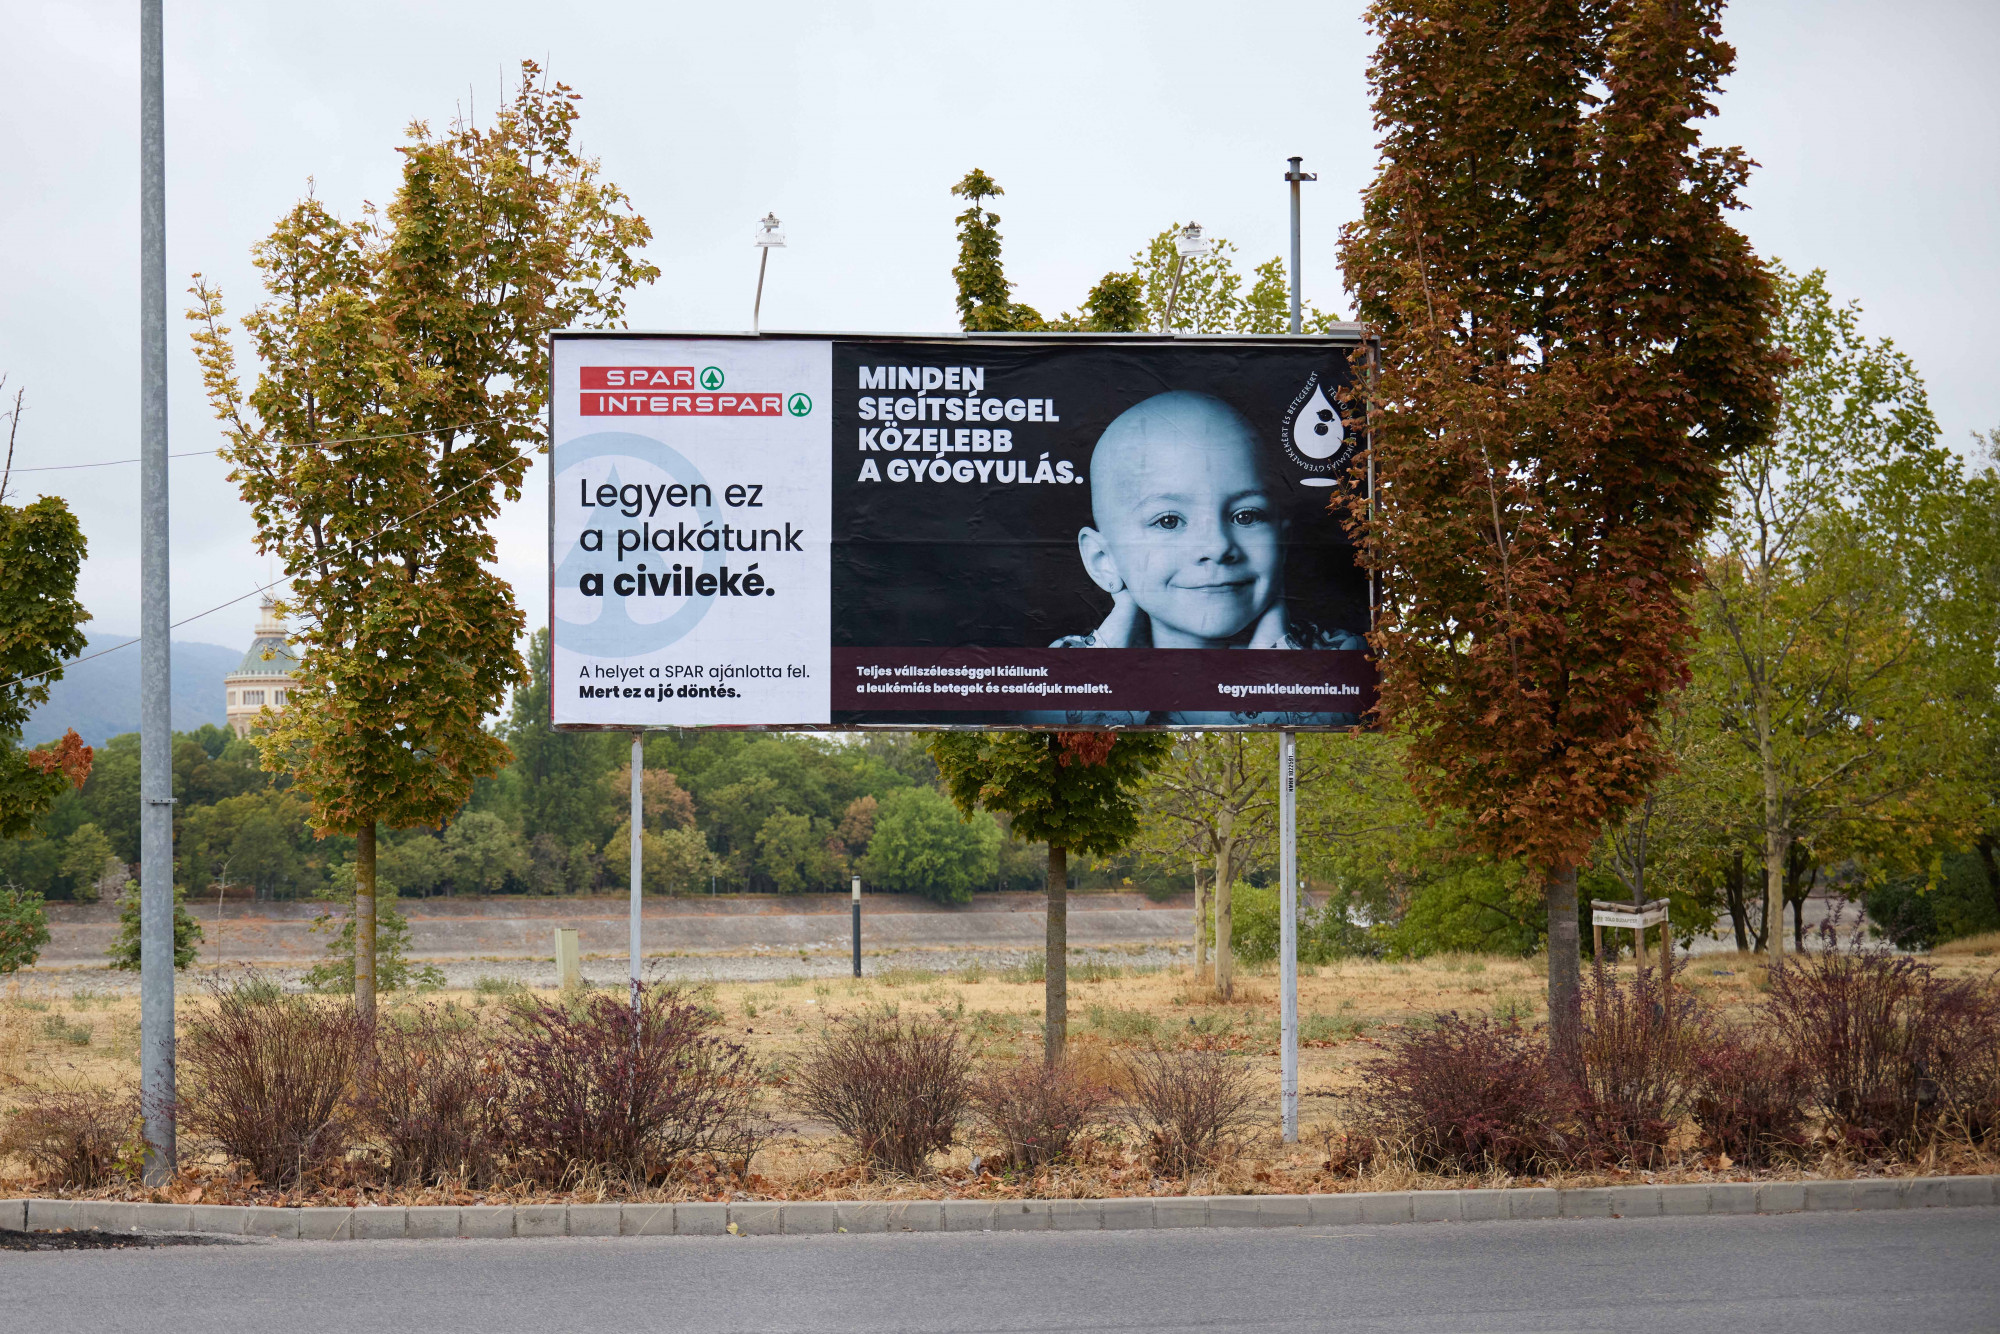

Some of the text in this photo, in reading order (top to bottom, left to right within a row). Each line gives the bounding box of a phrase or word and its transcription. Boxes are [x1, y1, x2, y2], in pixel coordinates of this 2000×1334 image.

[606, 369, 694, 386] SPAR
[858, 366, 984, 390] MINDEN
[599, 396, 781, 412] INTERSPAR
[858, 389, 1060, 422] SEGÍTSÉGGEL
[858, 421, 1013, 453] KÖZELEBB
[857, 451, 1084, 485] A GYÓGYULÁS.
[580, 478, 764, 518] Legyen ez
[579, 520, 804, 562] a plakátunk
[579, 563, 776, 597] a civileké.
[579, 664, 810, 683] A helyet a SPAR ajánlotta fel.
[856, 665, 1049, 680] Teljes vállszélességgel kiállunk
[579, 685, 741, 702] Mert ez a jó döntés.
[856, 683, 1113, 697] a leukémiás betegek és családjuk mellett.
[1217, 683, 1360, 698] tegyunkleukemia.hu
